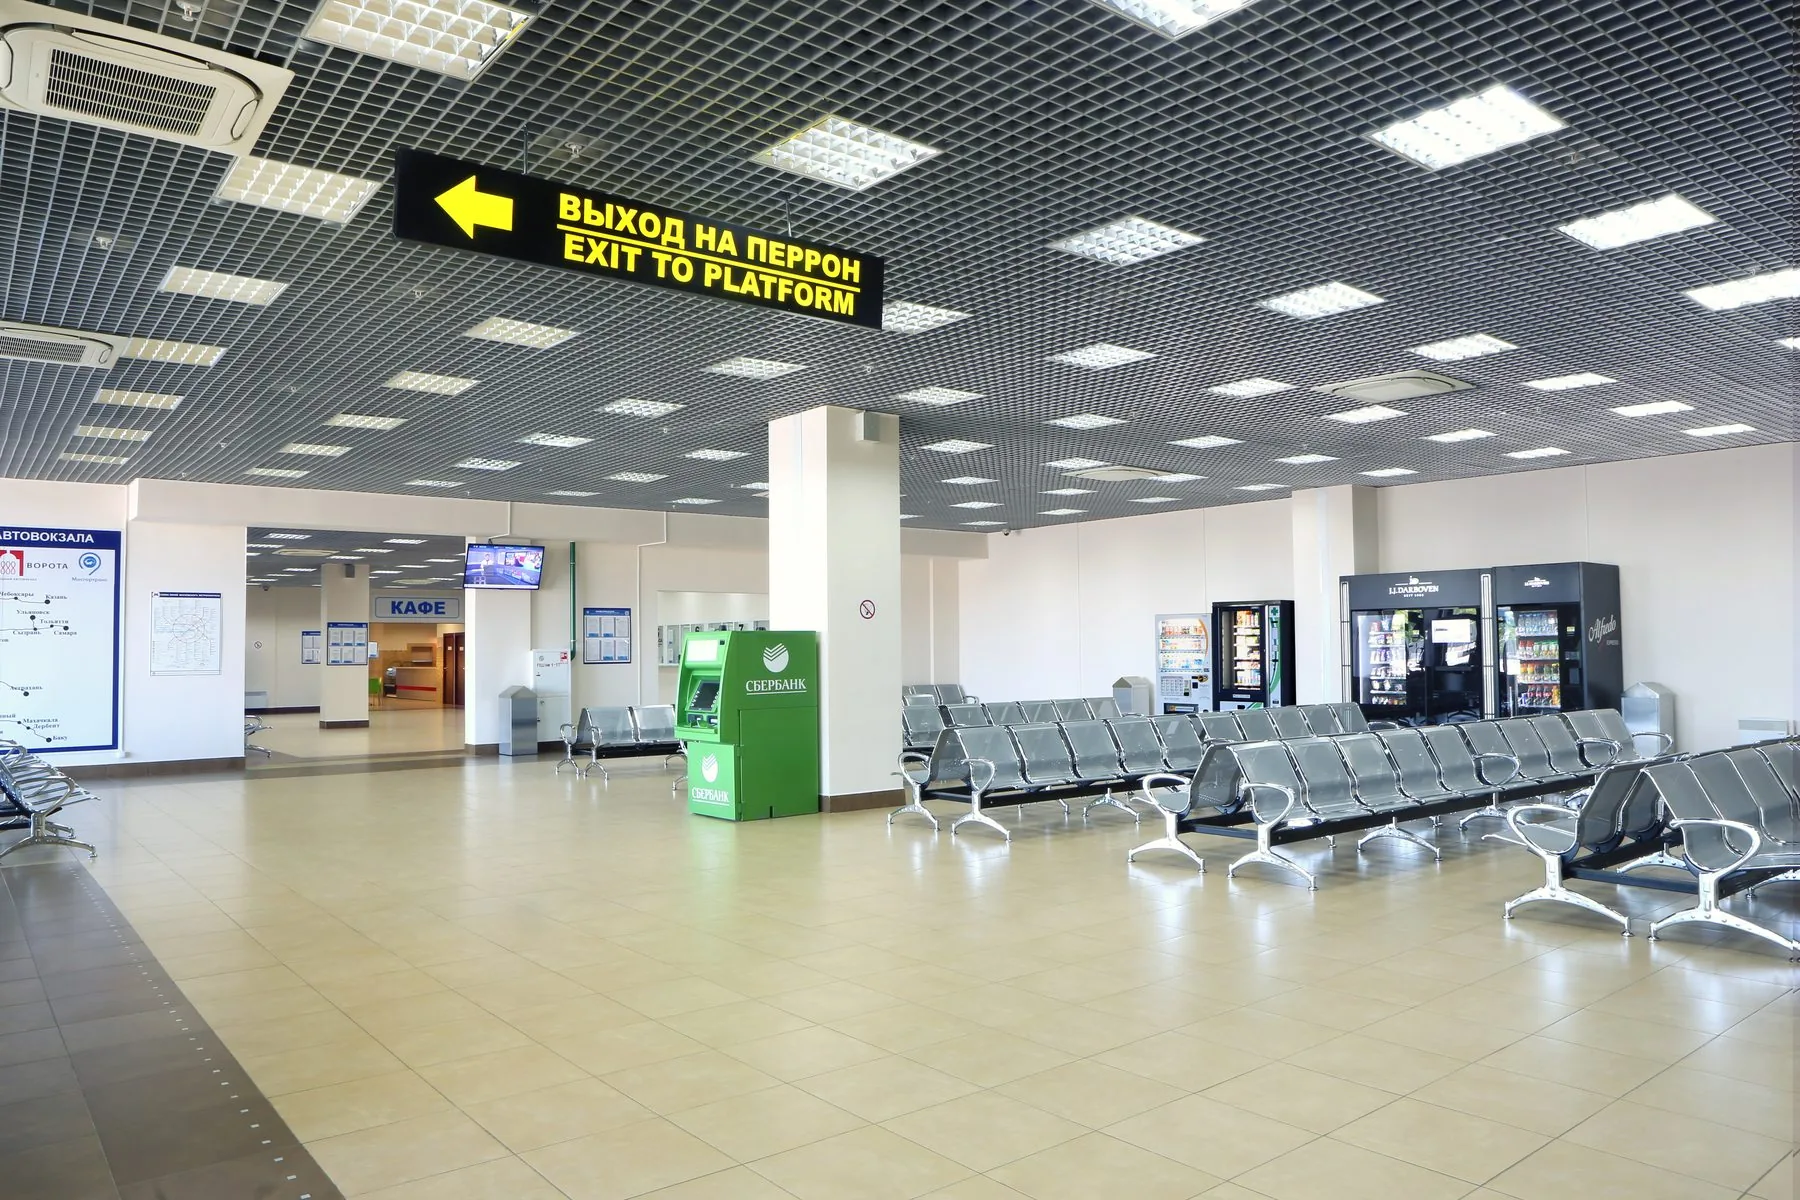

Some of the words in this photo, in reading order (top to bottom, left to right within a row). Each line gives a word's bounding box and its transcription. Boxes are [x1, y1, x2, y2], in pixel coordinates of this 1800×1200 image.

[559, 192, 685, 250] ВЫХОД
[695, 224, 738, 256] НА
[747, 236, 861, 283] ПЕРРОН
[563, 233, 642, 273] EXIT
[651, 251, 694, 283] TO
[704, 262, 855, 316] PLATFORM
[391, 601, 446, 615] КАФЕ
[1588, 614, 1617, 644] Alfredo
[745, 678, 807, 692] СБЕРБАНК
[692, 786, 729, 803] СБЕРБАНК
